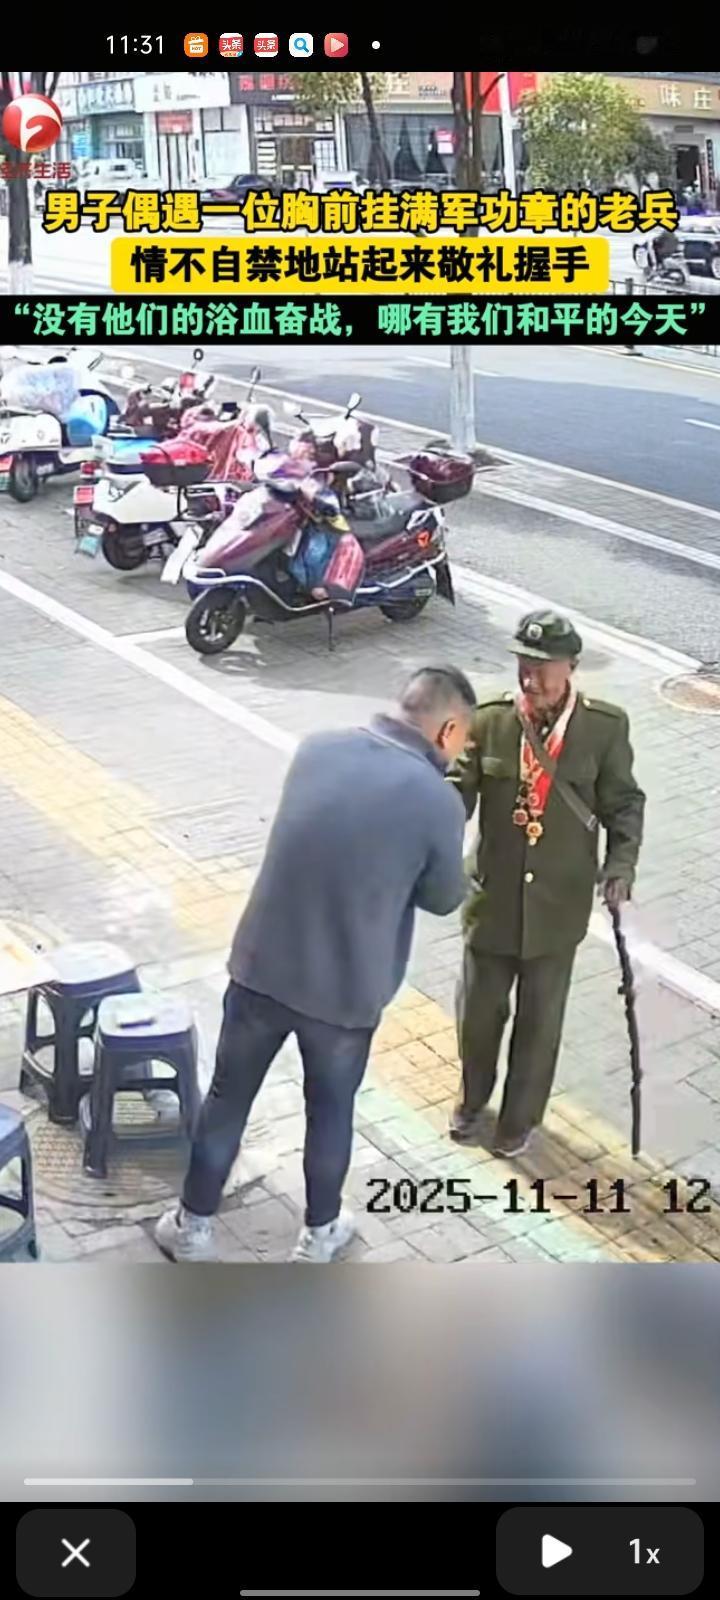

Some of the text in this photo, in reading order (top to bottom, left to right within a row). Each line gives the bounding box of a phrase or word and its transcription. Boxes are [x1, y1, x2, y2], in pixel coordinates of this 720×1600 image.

[106, 35, 163, 55] 11:31
[221, 39, 242, 51] 头条
[256, 39, 277, 51] 头条
[629, 1538, 661, 1565] 1x
